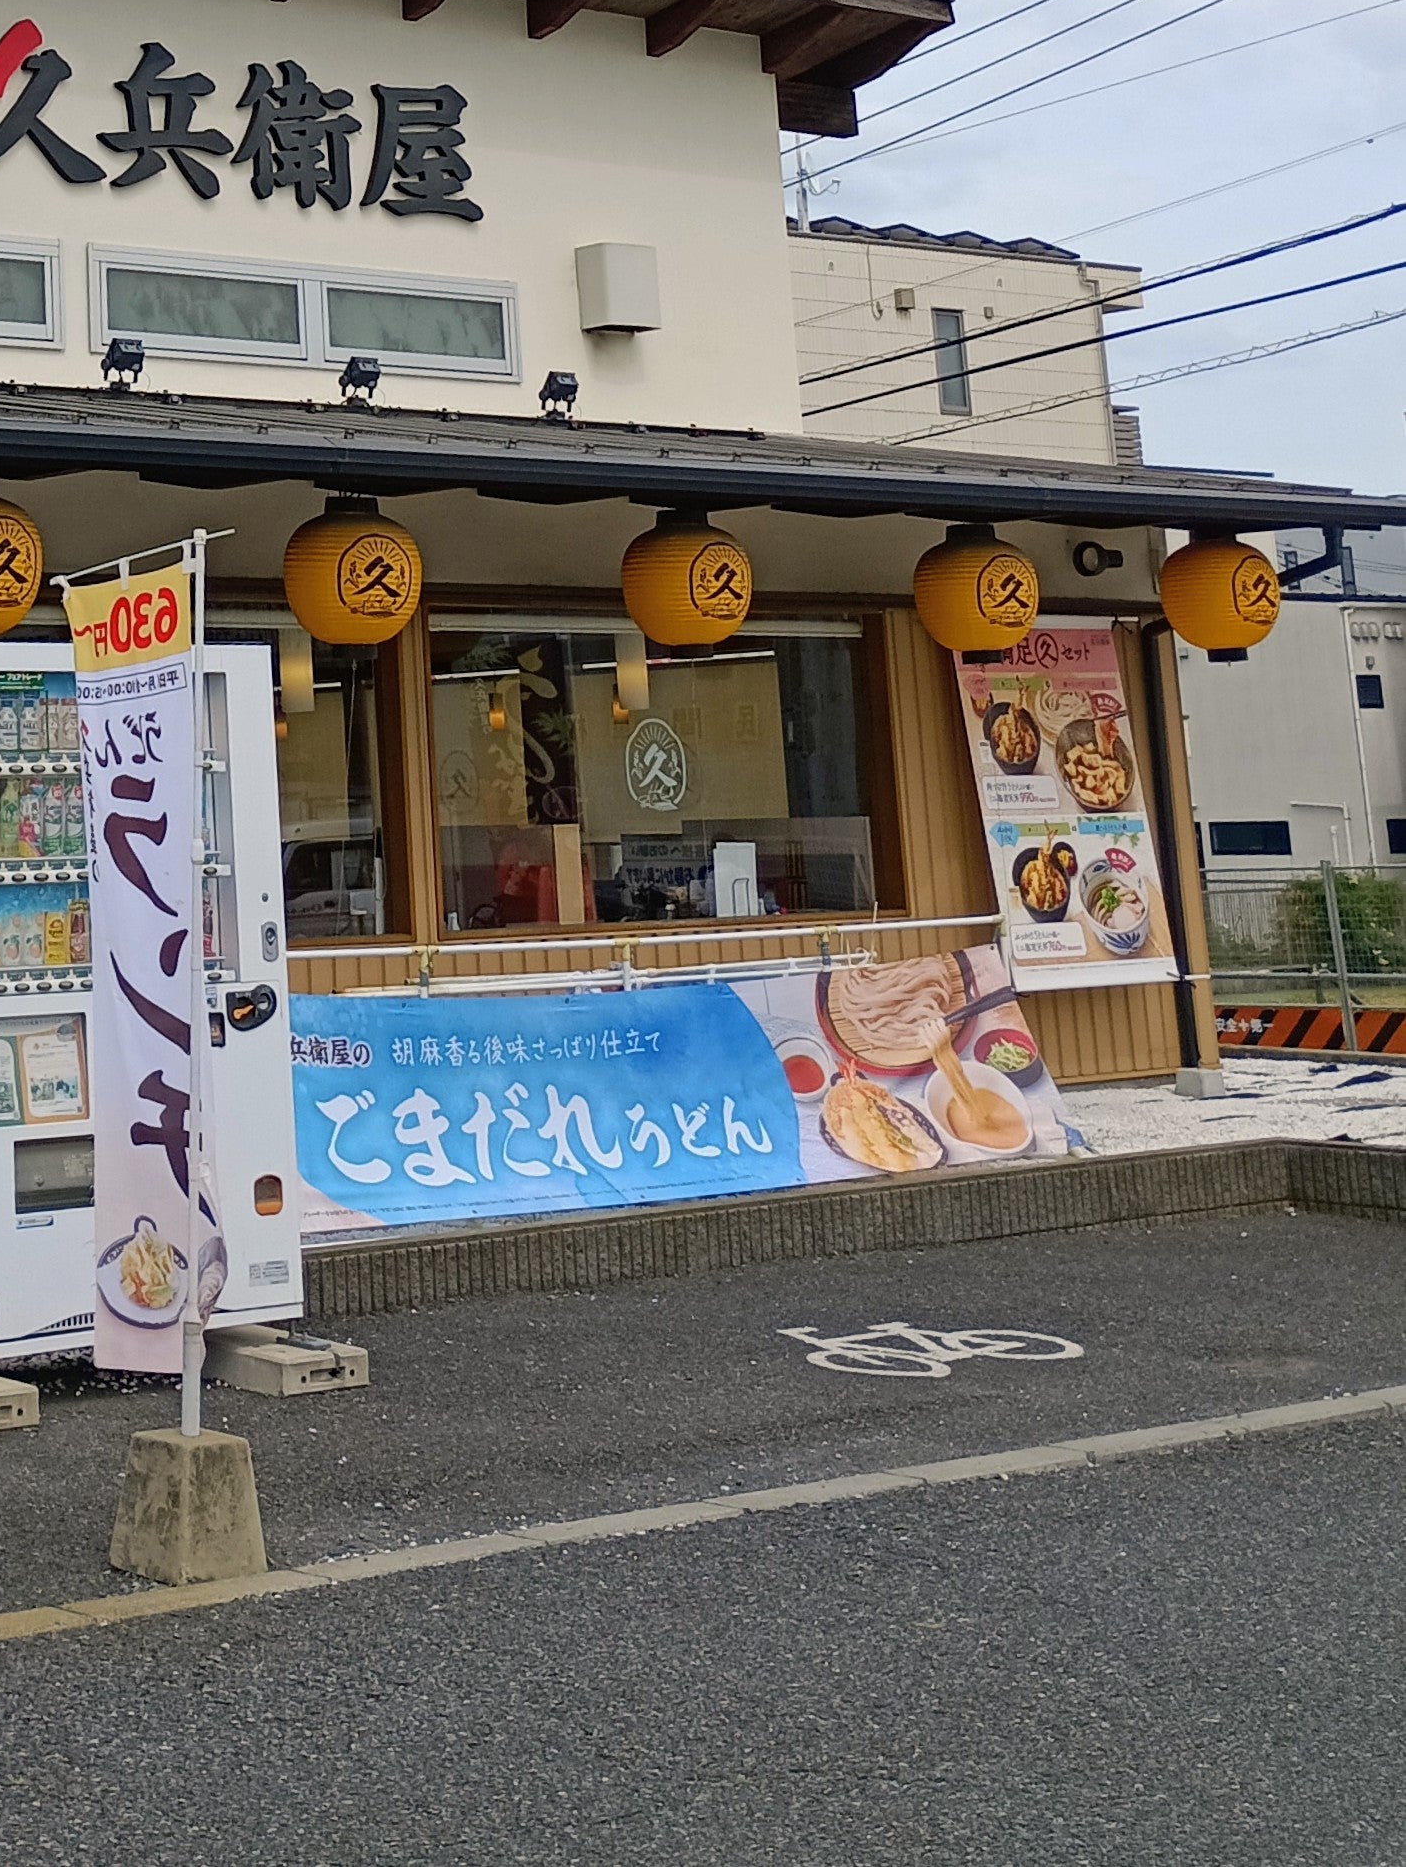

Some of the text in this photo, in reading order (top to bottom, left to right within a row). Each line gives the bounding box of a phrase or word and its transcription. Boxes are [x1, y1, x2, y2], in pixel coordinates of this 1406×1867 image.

[316, 1082, 774, 1187] ごまだれうどん
